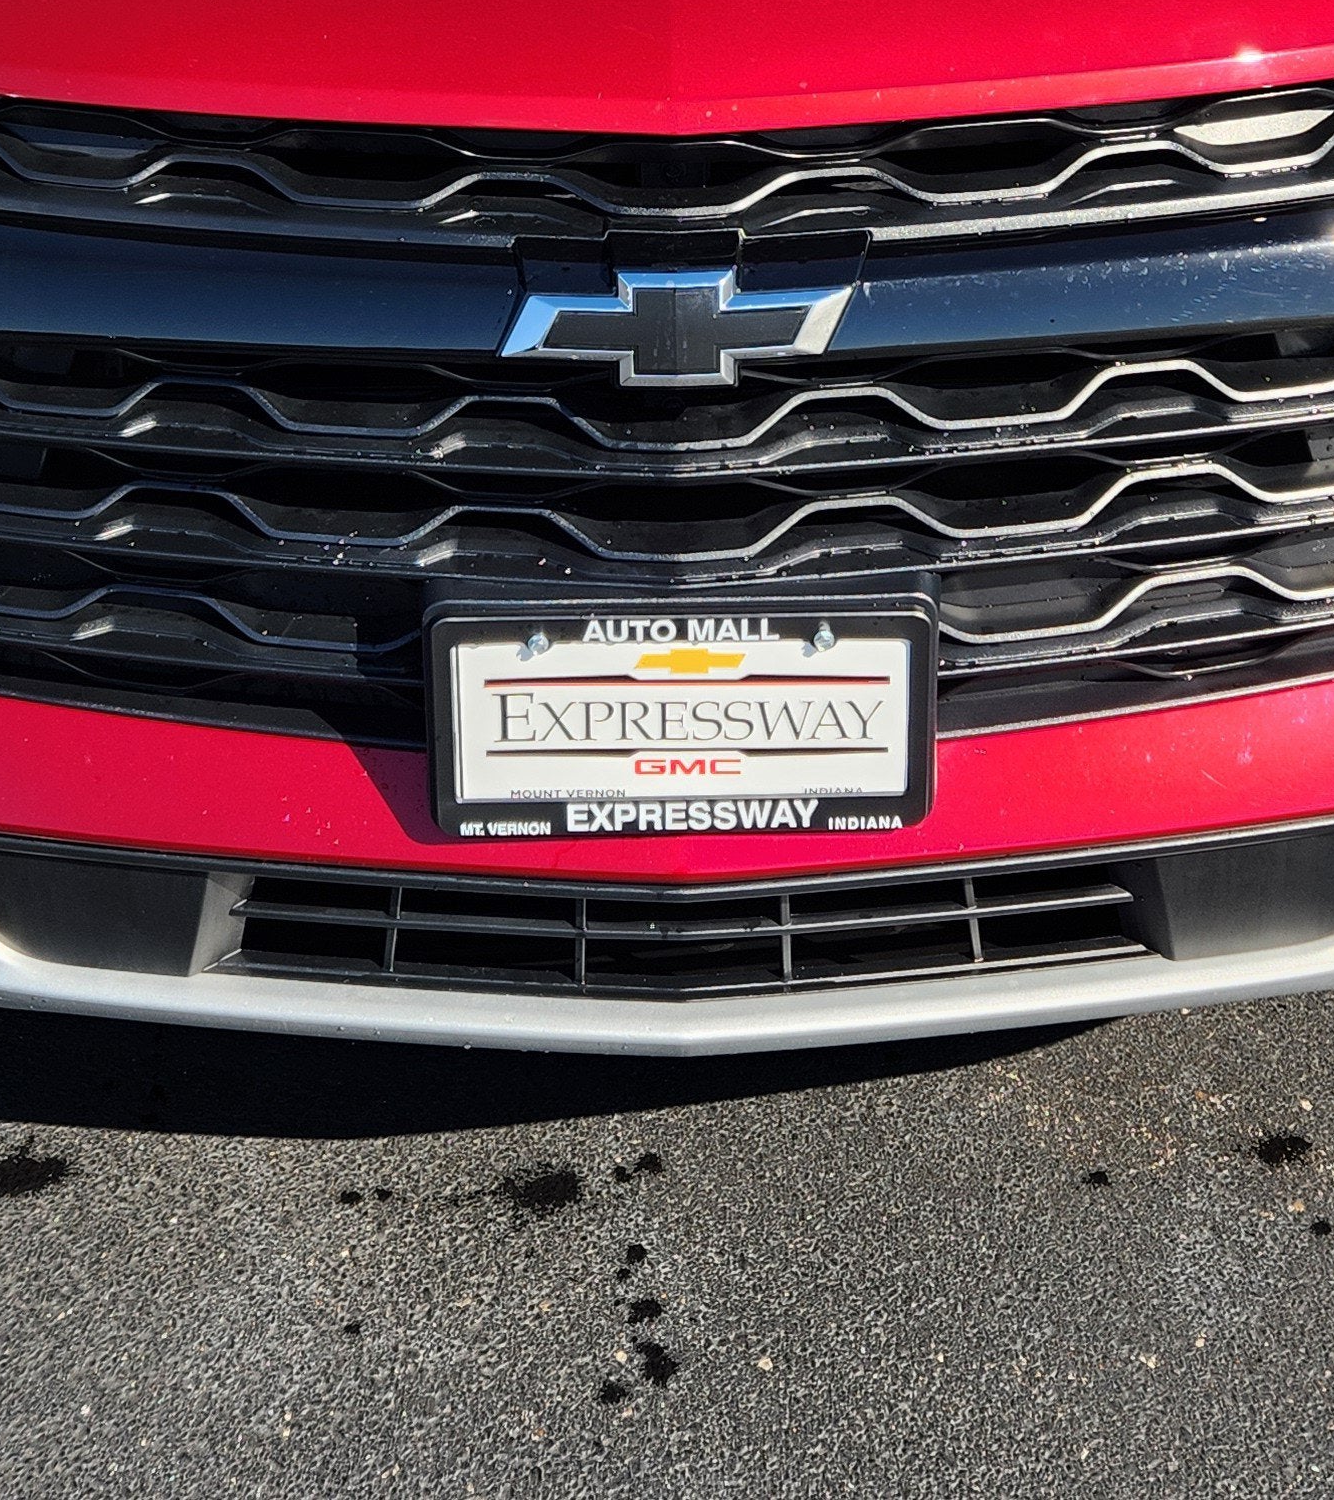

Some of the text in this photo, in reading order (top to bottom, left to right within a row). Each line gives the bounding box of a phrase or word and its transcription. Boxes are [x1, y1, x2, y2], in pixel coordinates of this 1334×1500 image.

[582, 618, 781, 644] AUTO MALL
[491, 692, 886, 744] EXPRESSWAY
[633, 758, 742, 776] GMC
[510, 788, 626, 799] MOUNT VERNON
[804, 786, 863, 795] INDIANA
[567, 799, 819, 832] EXPRESSWAY
[828, 815, 904, 831] INDIANA
[460, 820, 552, 837] MT. VERNON
